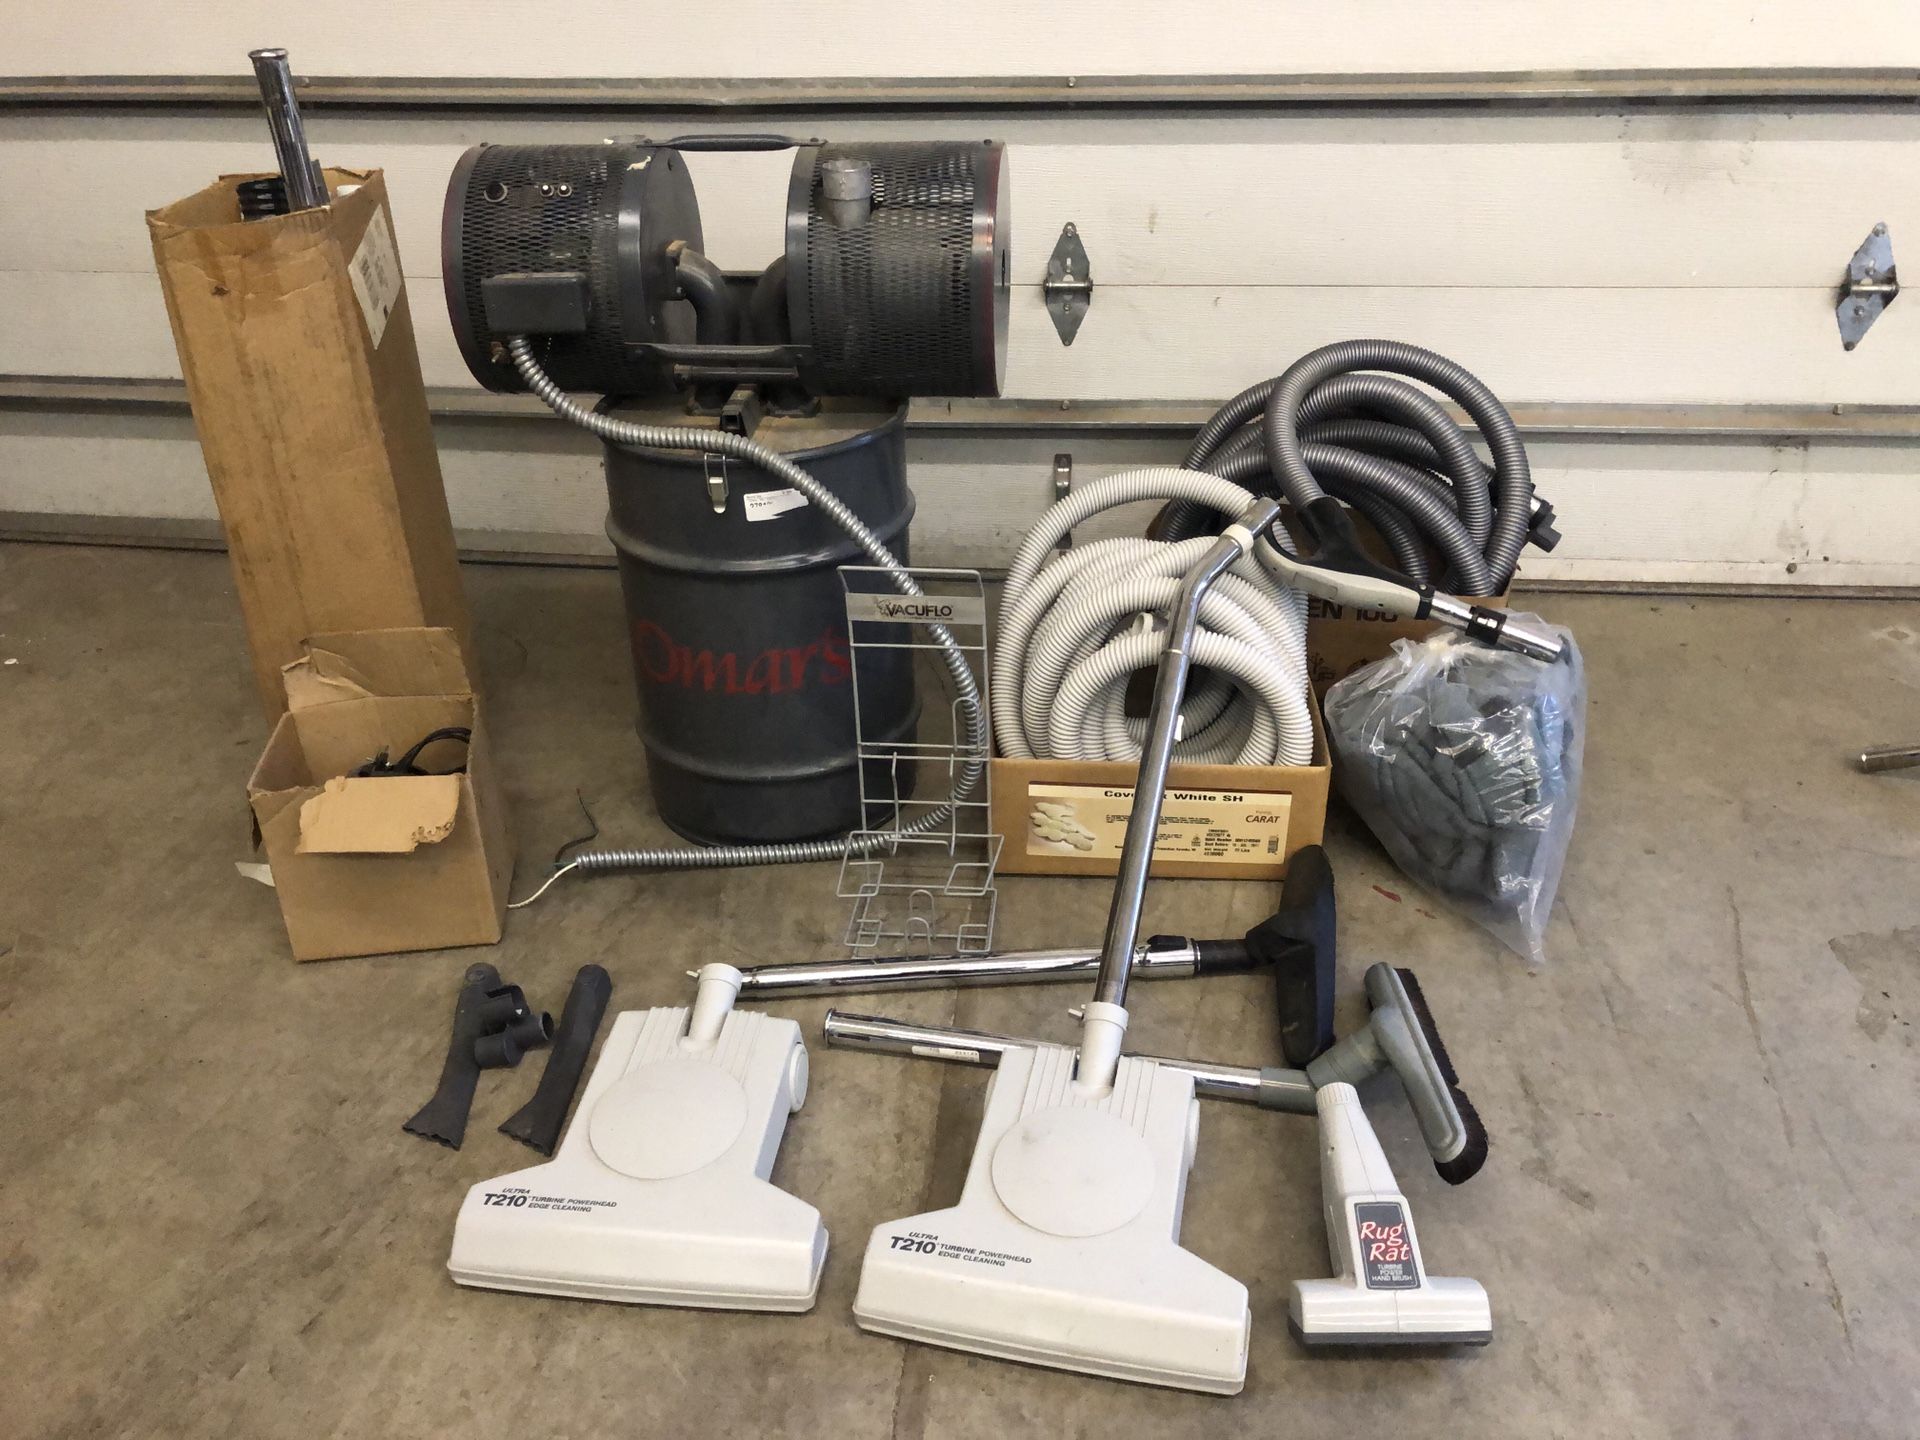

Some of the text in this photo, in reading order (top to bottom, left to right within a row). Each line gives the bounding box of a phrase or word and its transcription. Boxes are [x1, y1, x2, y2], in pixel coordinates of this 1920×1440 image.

[886, 603, 952, 617] VACUFLO
[1174, 793, 1217, 802] White
[1245, 815, 1280, 823] CARAT
[483, 1193, 617, 1208] T210 TURBINE POWERHEAD
[528, 1202, 592, 1213] EDGE CLEANING
[908, 1231, 939, 1241] ULTRA
[1361, 1221, 1403, 1246] Rug
[890, 1236, 1032, 1264] T210 TURBINE POWERHEAD
[1369, 1242, 1409, 1262] Rat
[938, 1250, 1006, 1267] EDGE CLEANING
